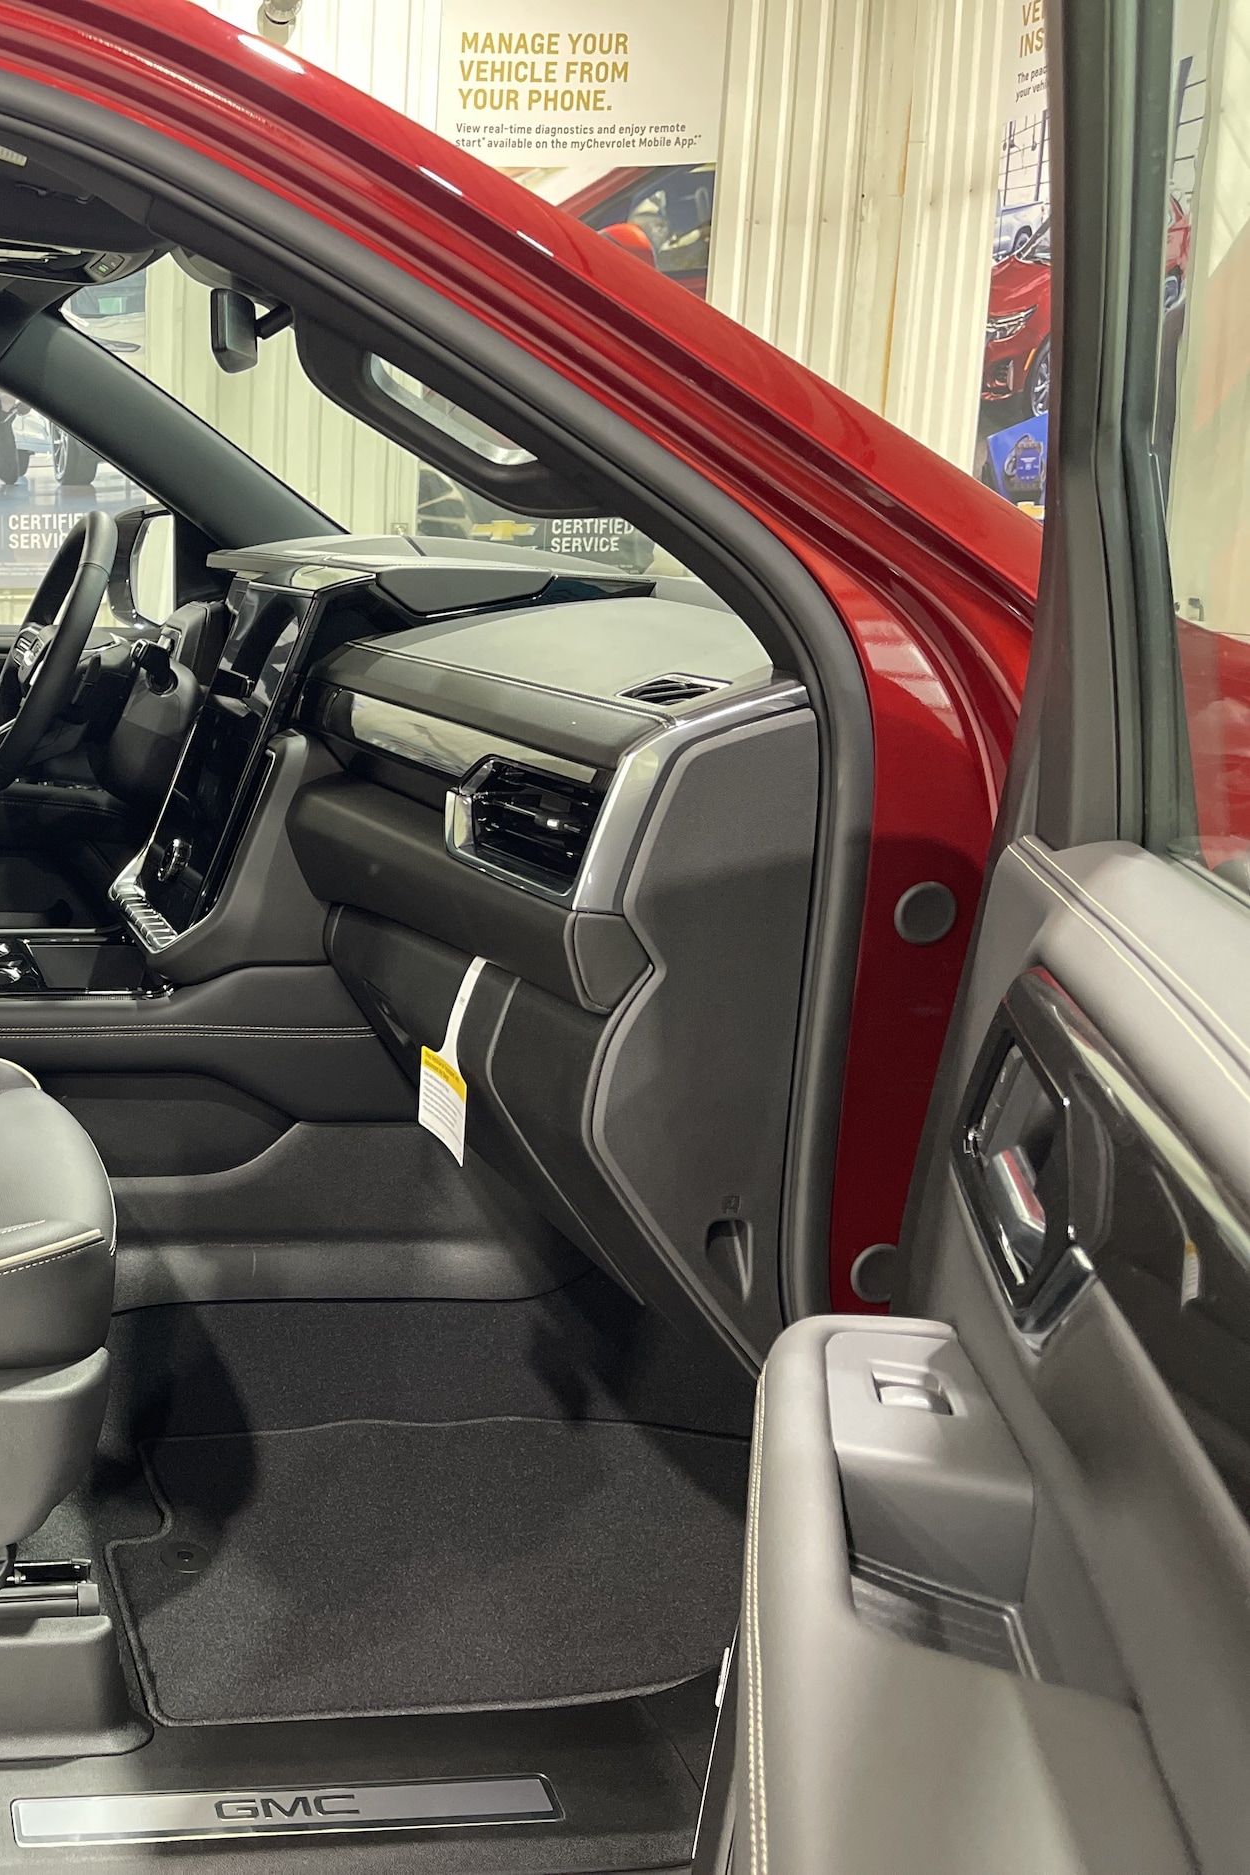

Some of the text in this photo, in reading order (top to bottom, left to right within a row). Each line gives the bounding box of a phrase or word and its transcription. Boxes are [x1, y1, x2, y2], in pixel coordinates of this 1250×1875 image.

[461, 31, 628, 55] MANAGE YOUR
[459, 60, 629, 83] VEHICLE FROM
[1017, 71, 1029, 84] The
[458, 88, 612, 111] YOUR PHONE.
[1015, 86, 1031, 103] your
[456, 122, 686, 137] View real-time diagnostics and enjoy remote
[487, 138, 533, 149] available
[535, 140, 548, 149] on
[550, 138, 568, 149] the
[570, 138, 636, 151] myChevrolet
[638, 137, 672, 148] Mobile
[8, 512, 88, 530] CERTIFI
[551, 518, 634, 535] CERTIFIED
[550, 537, 620, 553] SERVICE
[214, 1794, 361, 1821] GMC
